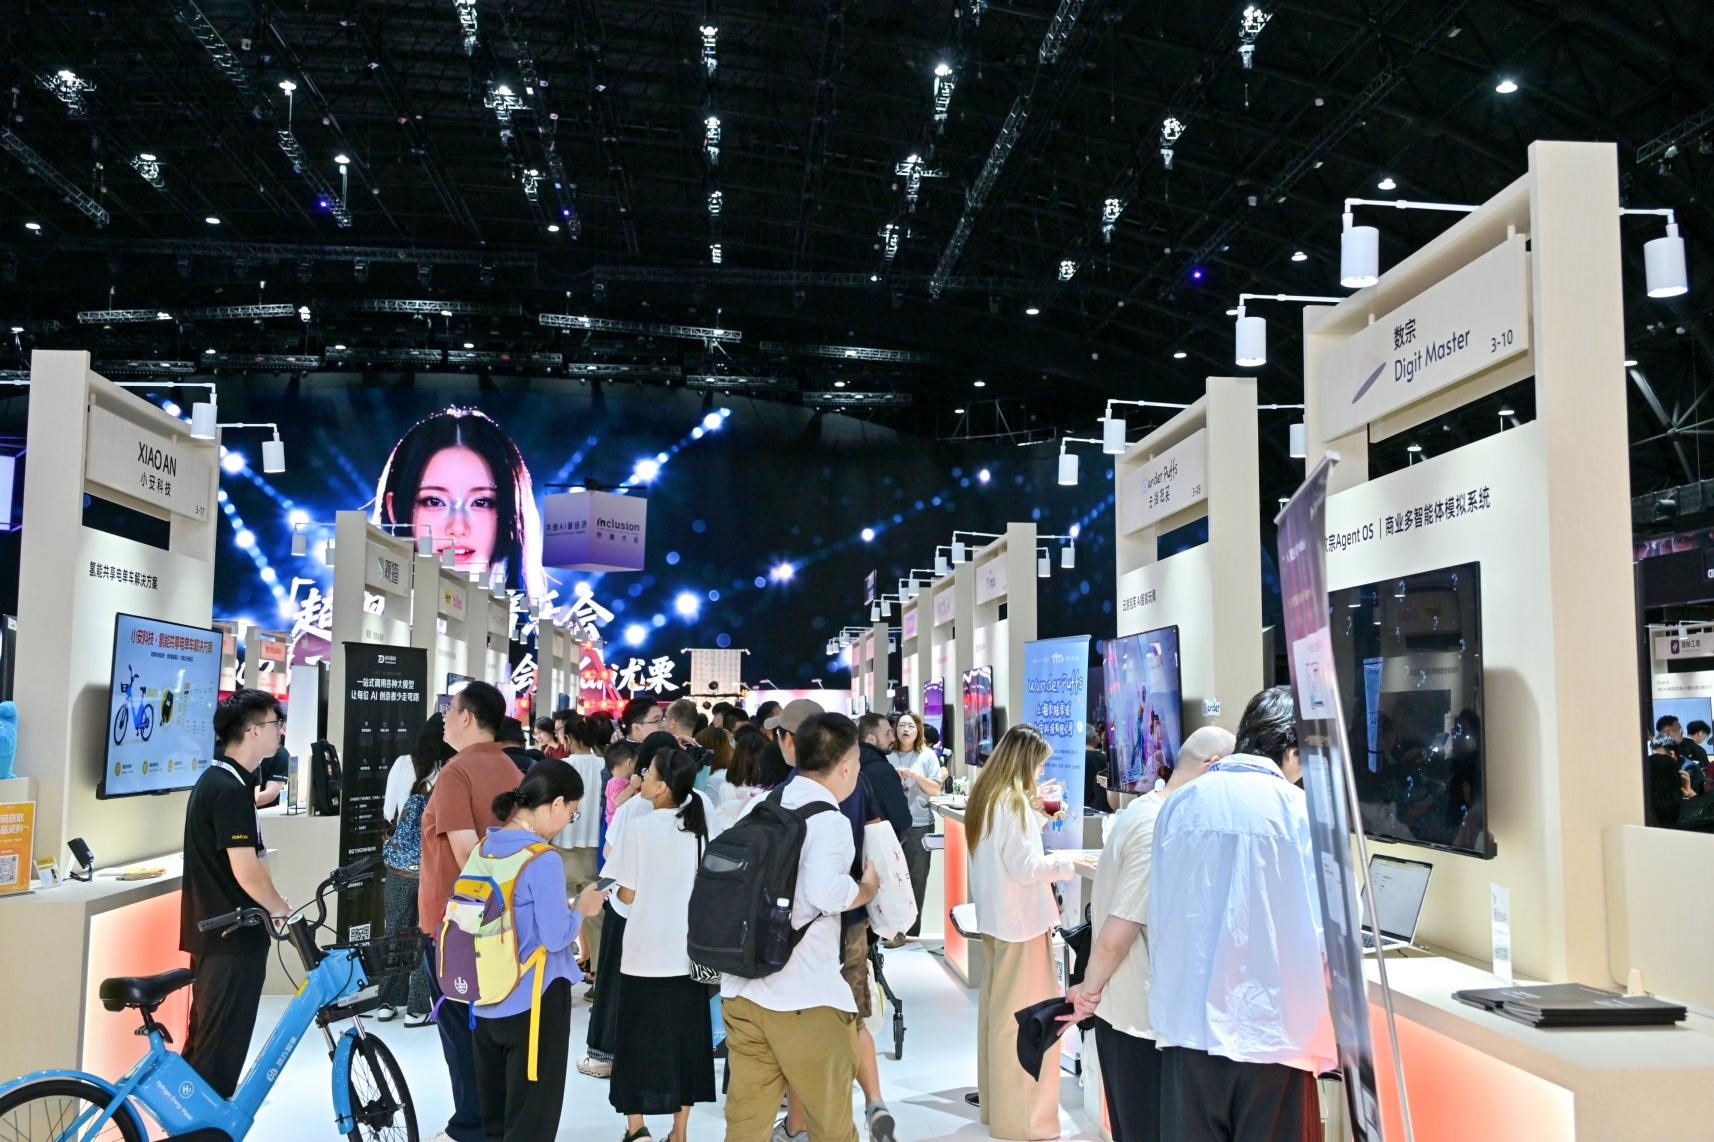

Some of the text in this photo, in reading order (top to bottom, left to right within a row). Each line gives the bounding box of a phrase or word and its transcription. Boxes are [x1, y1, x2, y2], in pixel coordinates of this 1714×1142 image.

[1394, 319, 1416, 351] 数宗
[1491, 329, 1513, 352] 3-10
[1394, 330, 1470, 382] Digit Master
[138, 441, 177, 477] XIAOAN
[140, 472, 171, 497] 小安科技
[1362, 523, 1374, 541] OS
[1385, 485, 1491, 536] 商业多智能体模拟系统
[351, 690, 420, 702] 让每位 AI 创造者少走弯路
[356, 677, 415, 690] 一站式调用各种大模型
